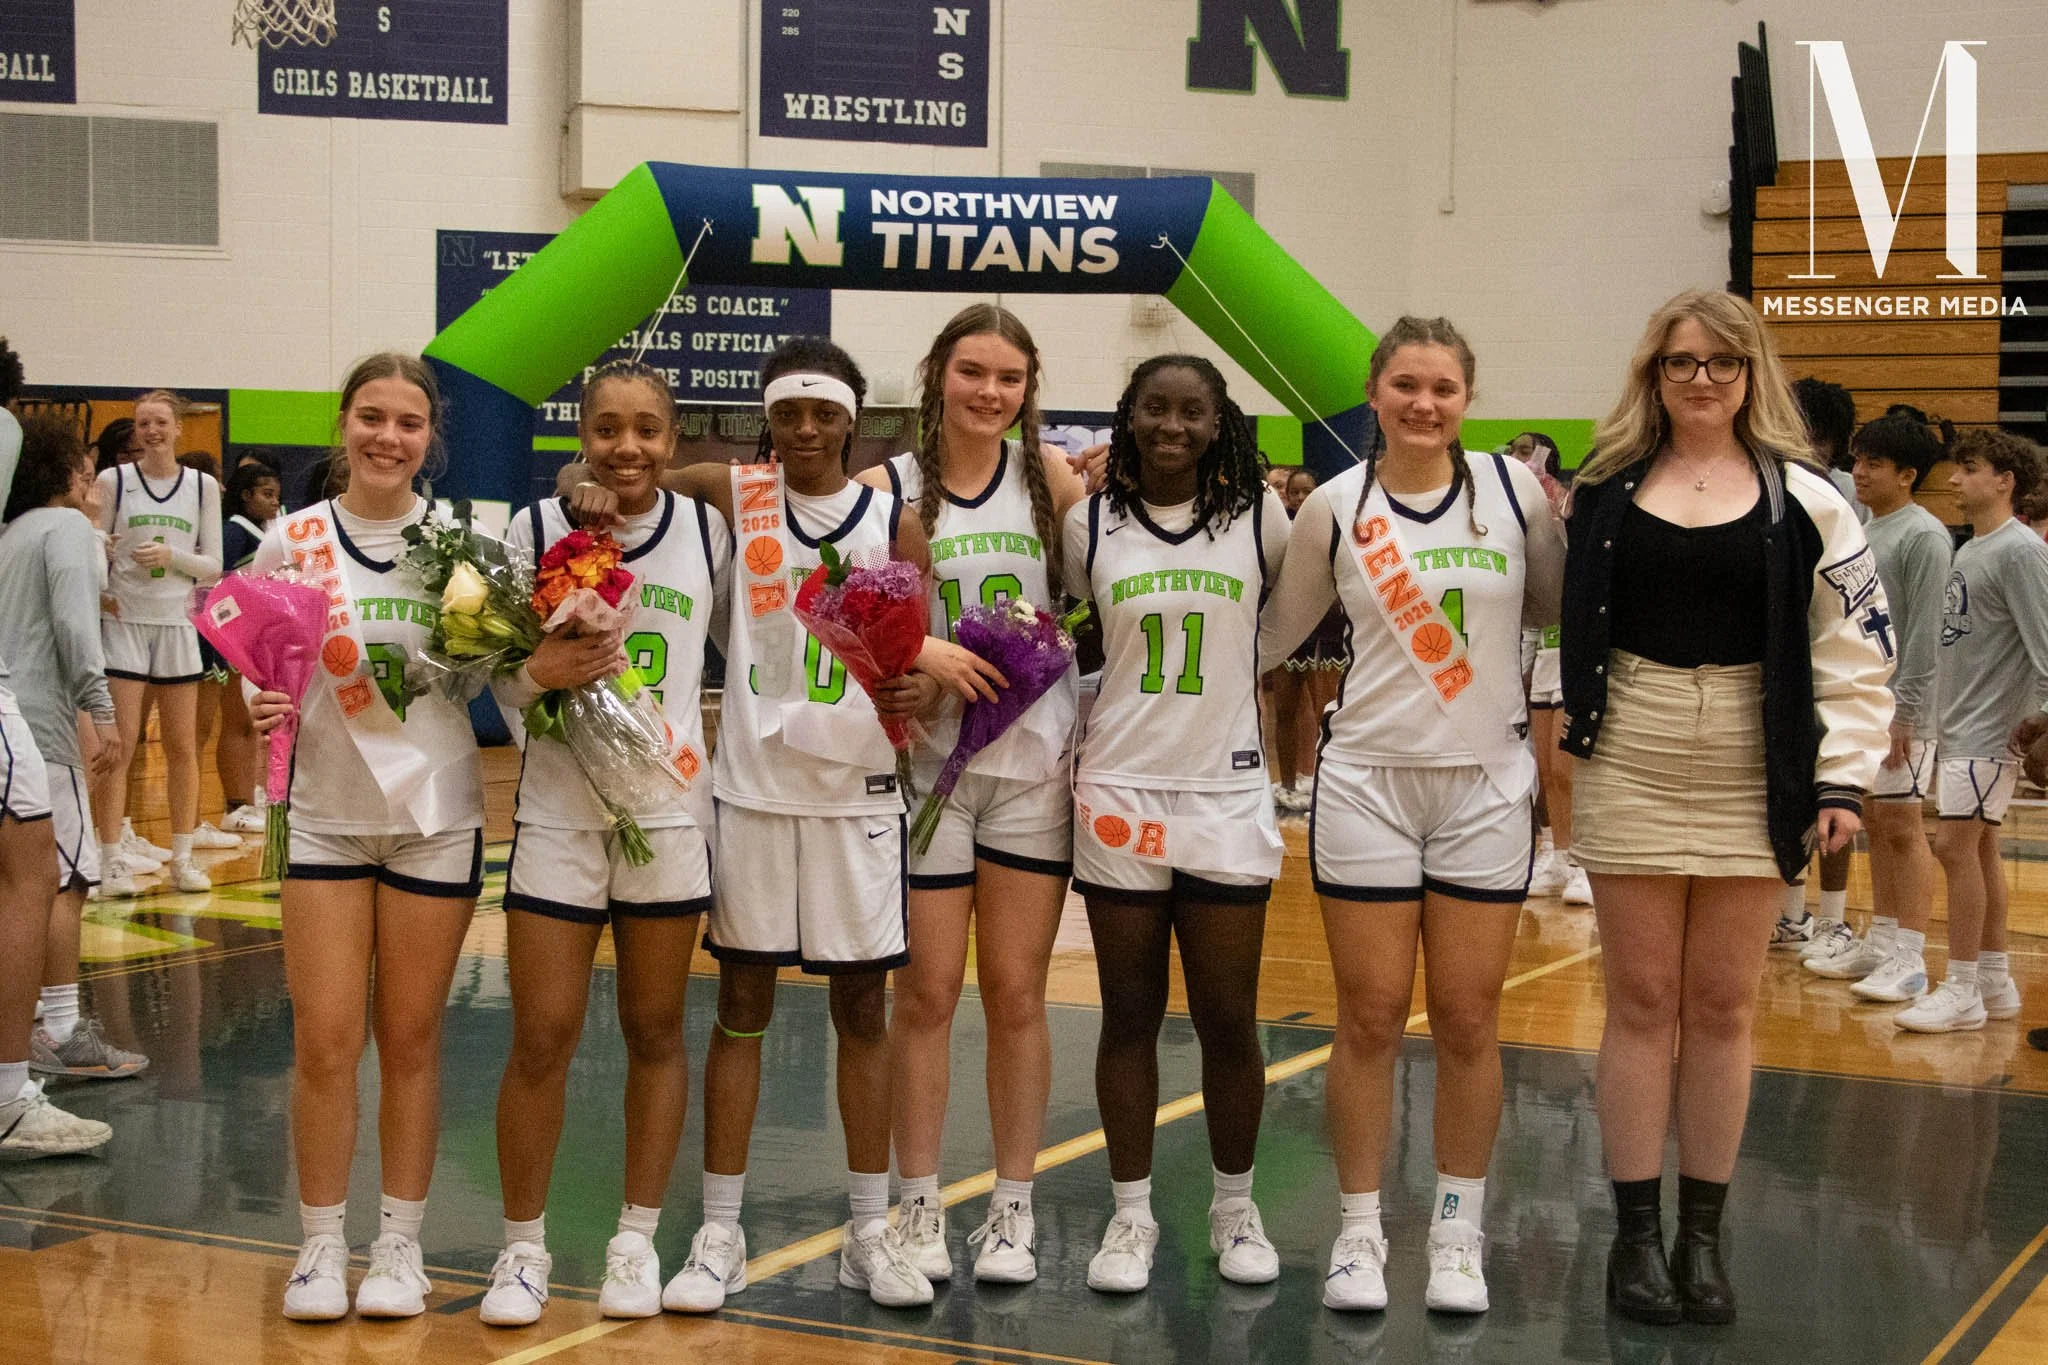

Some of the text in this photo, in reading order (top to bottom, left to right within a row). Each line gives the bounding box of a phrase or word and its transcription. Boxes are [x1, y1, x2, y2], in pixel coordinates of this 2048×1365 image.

[379, 6, 391, 32] S
[782, 8, 800, 18] 220
[933, 7, 970, 36] N
[782, 27, 800, 36] 285
[938, 53, 964, 80] S
[273, 68, 493, 104] GIRLS BASKETBALL
[783, 93, 967, 128] WRESTLING
[871, 189, 1119, 221] NORTHVIEW
[751, 183, 846, 267] N
[872, 221, 1120, 275] TITANS
[656, 295, 789, 317] ES COACH."
[612, 331, 682, 351] CIALS
[742, 514, 779, 534] 2026
[1111, 569, 1244, 606] NORTHVIEW
[1140, 612, 1204, 695] 11
